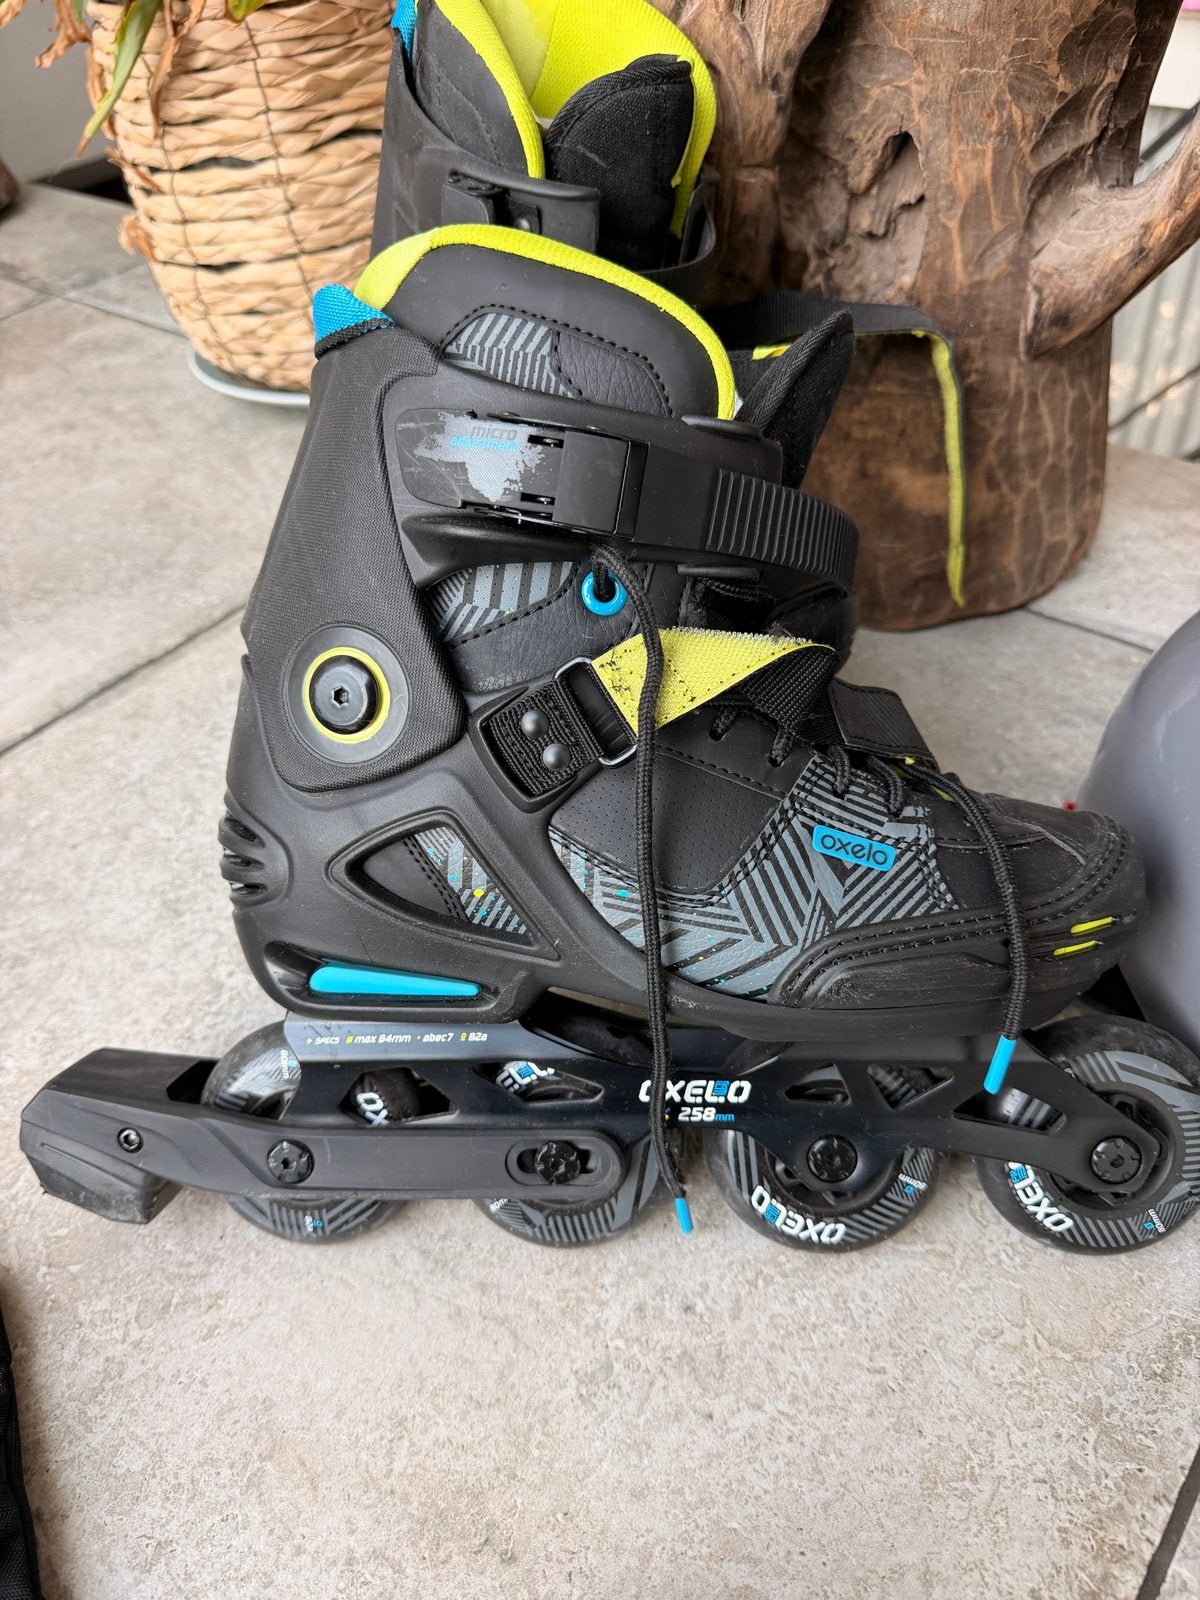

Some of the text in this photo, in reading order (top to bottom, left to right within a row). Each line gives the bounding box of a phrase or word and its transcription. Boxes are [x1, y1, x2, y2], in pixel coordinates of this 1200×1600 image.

[471, 426, 518, 440] micro
[821, 834, 887, 865] oxelo
[314, 1036, 340, 1045] SPECS
[354, 1035, 377, 1044] max
[422, 1032, 454, 1042] abec7
[677, 1106, 735, 1121] 258mm
[751, 1185, 846, 1244] OXELO
